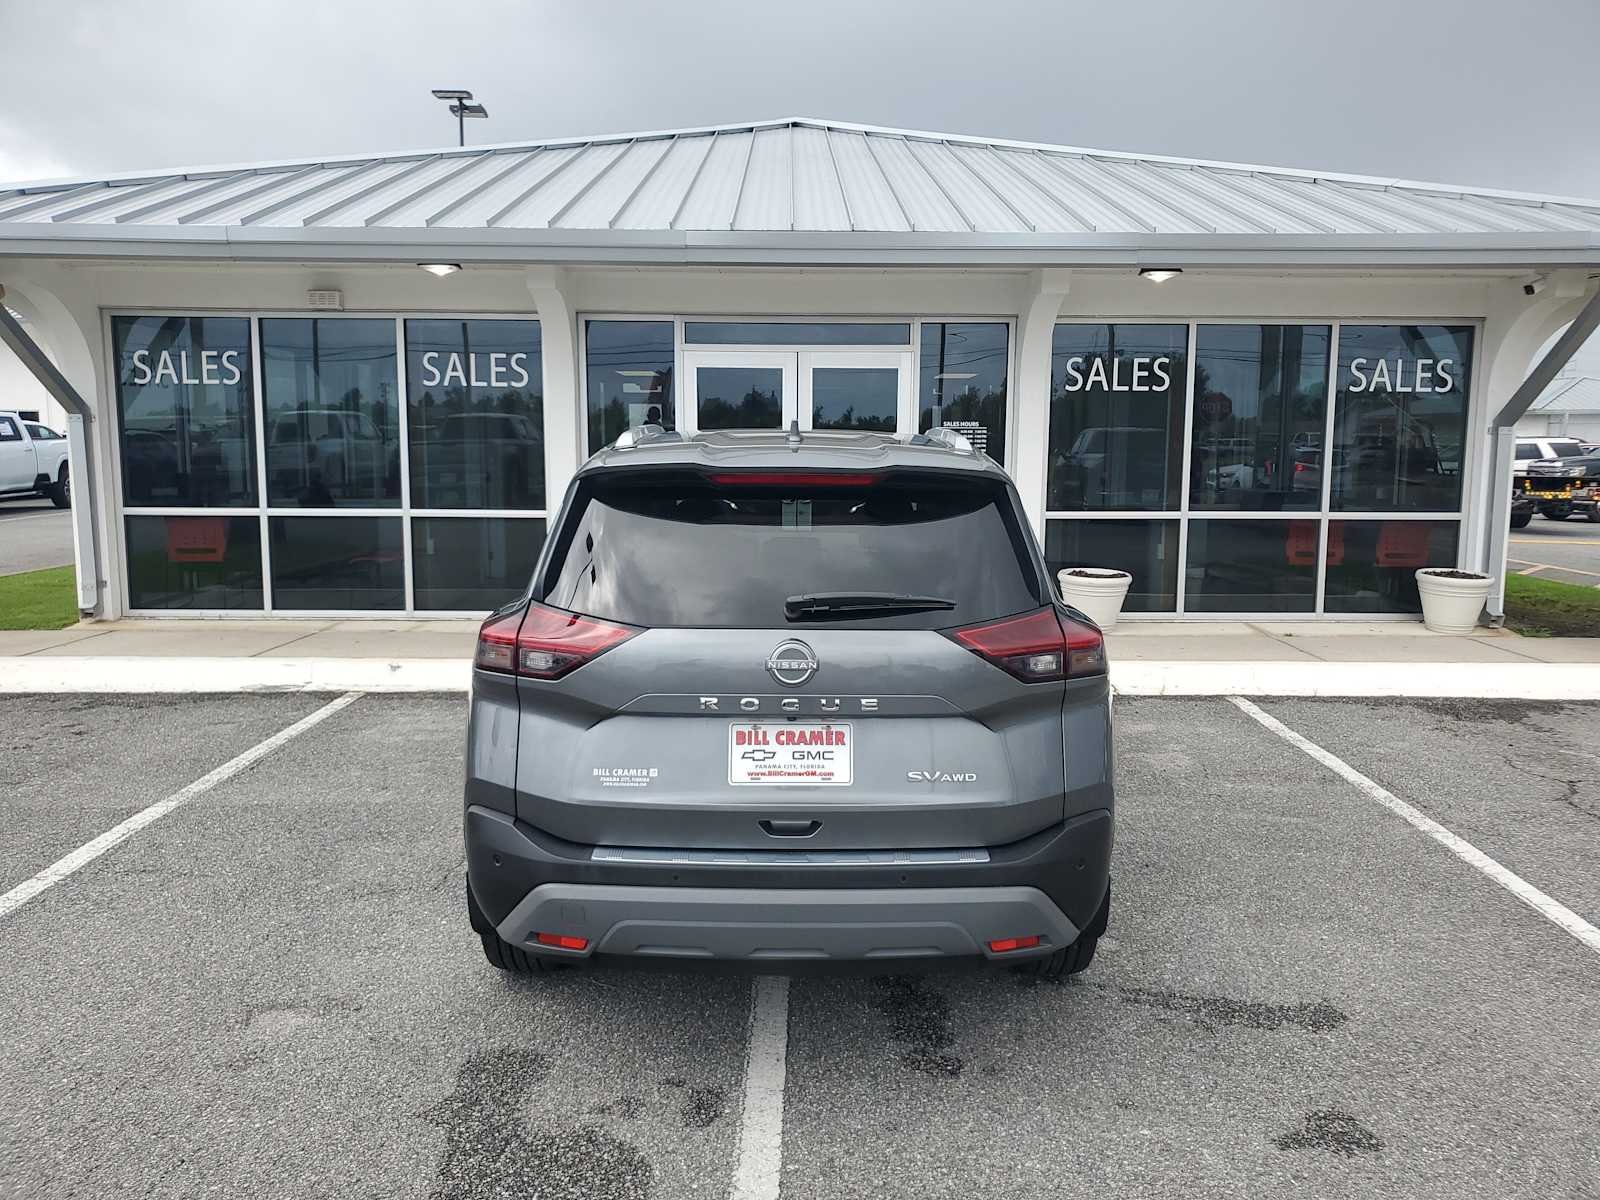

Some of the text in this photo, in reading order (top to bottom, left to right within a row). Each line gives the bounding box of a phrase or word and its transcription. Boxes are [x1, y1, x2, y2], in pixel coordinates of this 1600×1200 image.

[132, 349, 241, 385] SALES
[422, 351, 529, 387] SALES
[1064, 357, 1170, 392] SALES
[1348, 358, 1454, 393] SALES
[767, 661, 817, 669] NISSAN
[699, 697, 880, 711] ROGUE
[735, 730, 846, 746] BILL CRAMER
[791, 751, 835, 761] GMC
[592, 768, 648, 777] BILL CRAMER
